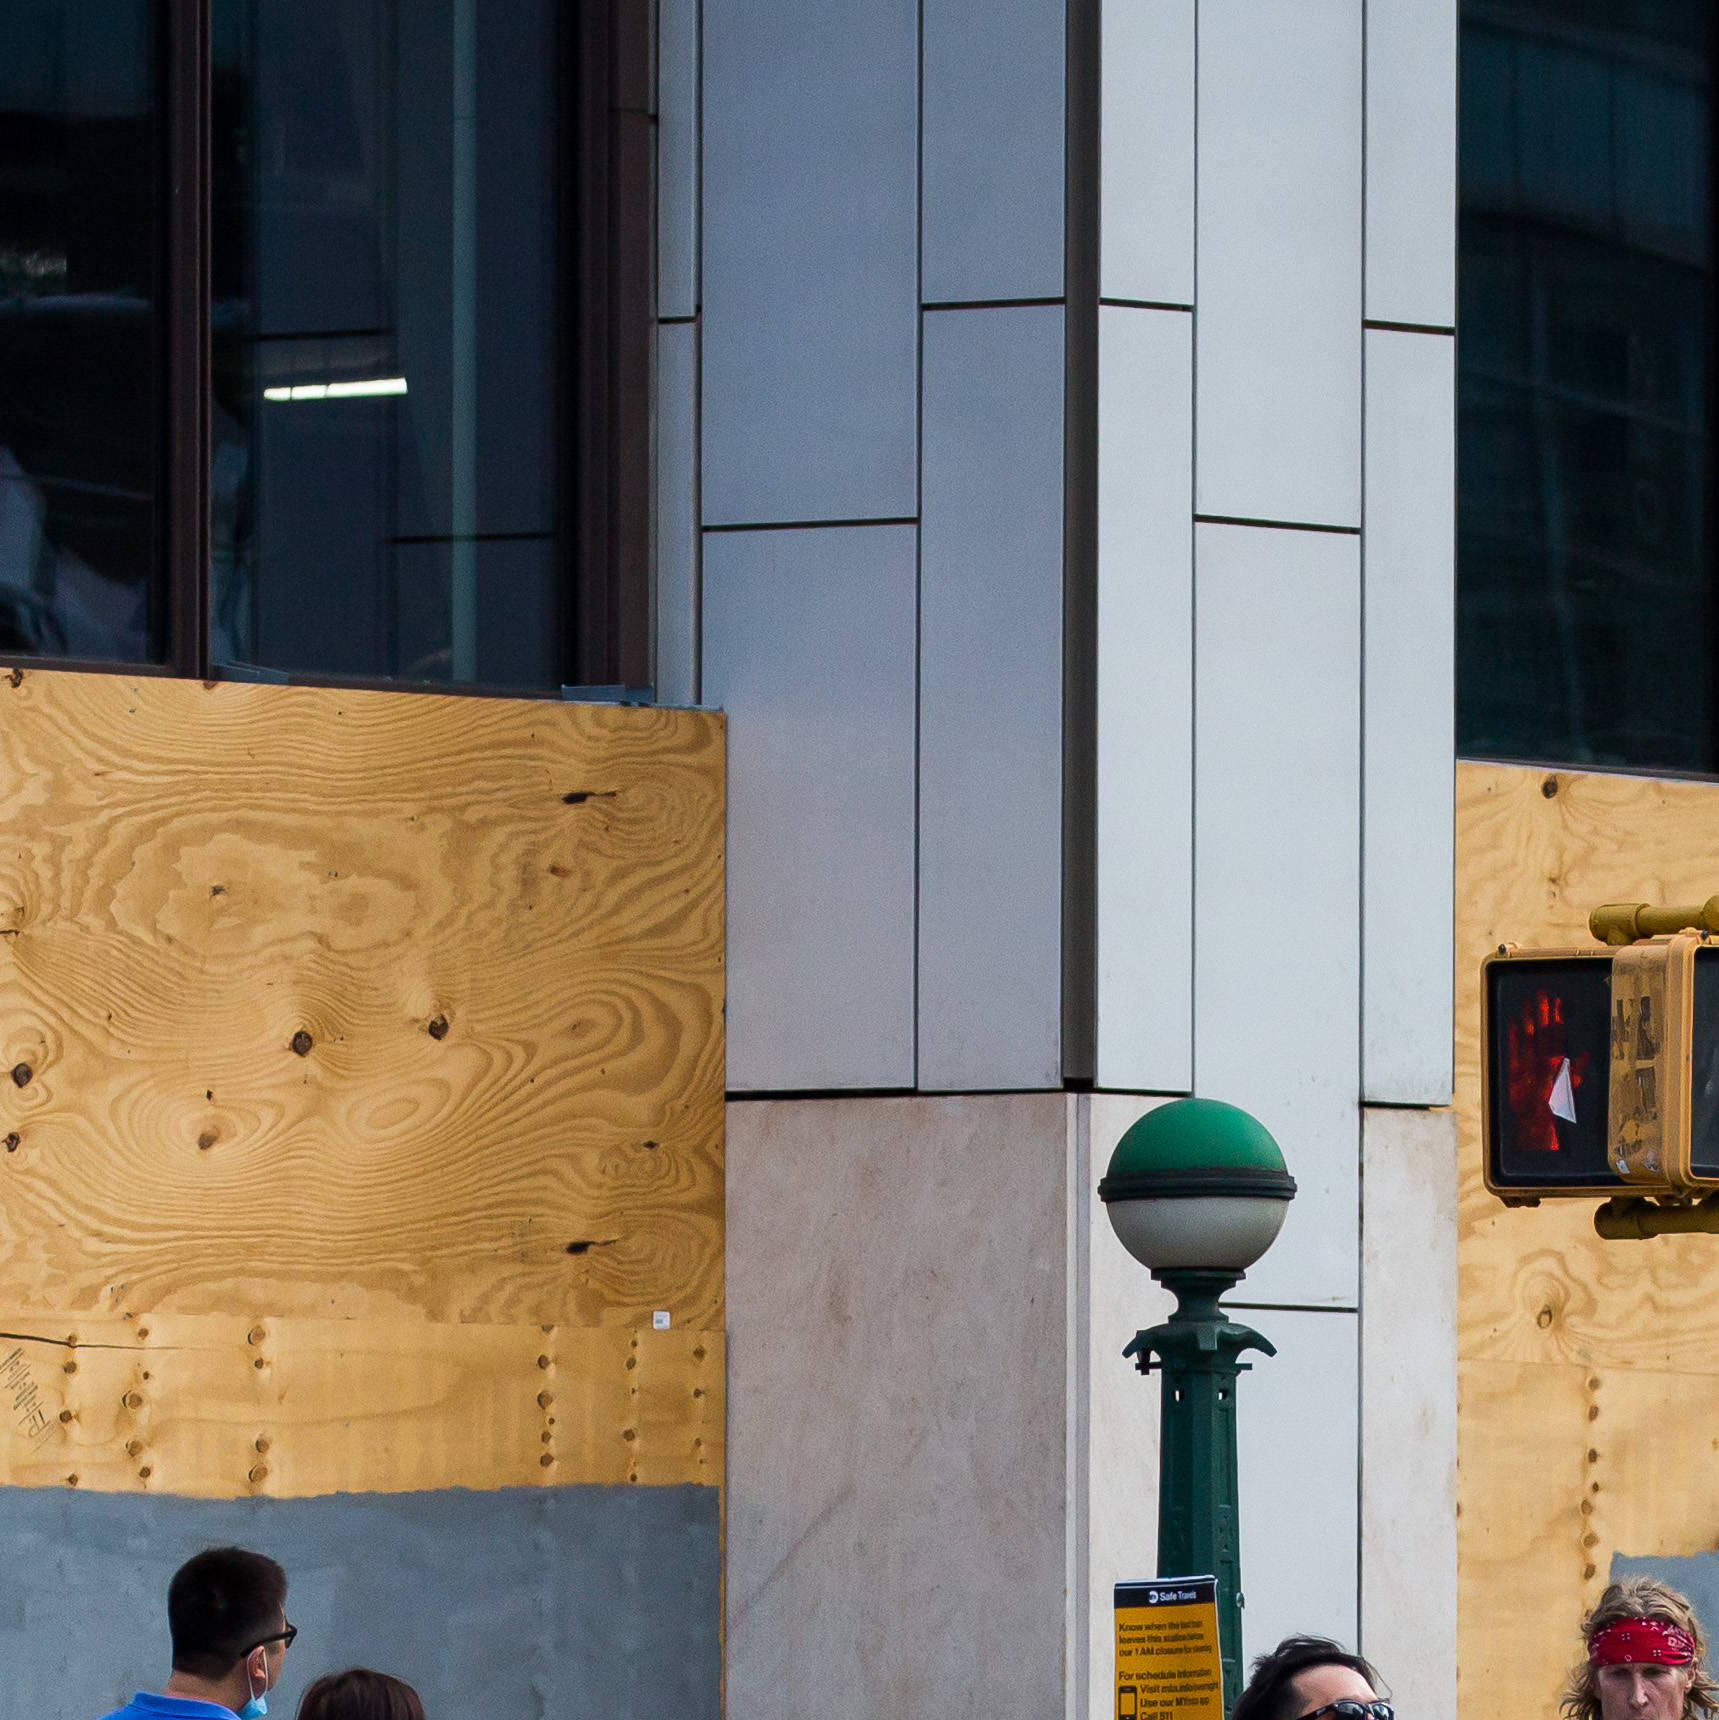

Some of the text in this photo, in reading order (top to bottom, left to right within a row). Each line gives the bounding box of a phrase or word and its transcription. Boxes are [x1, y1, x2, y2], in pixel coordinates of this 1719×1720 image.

[1159, 1591, 1177, 1601] Safe
[1118, 1671, 1134, 1681] For
[1136, 1670, 1176, 1681] schedule
[1140, 1684, 1160, 1694] Visit
[1140, 1698, 1158, 1708] Use
[1159, 1699, 1174, 1708] our
